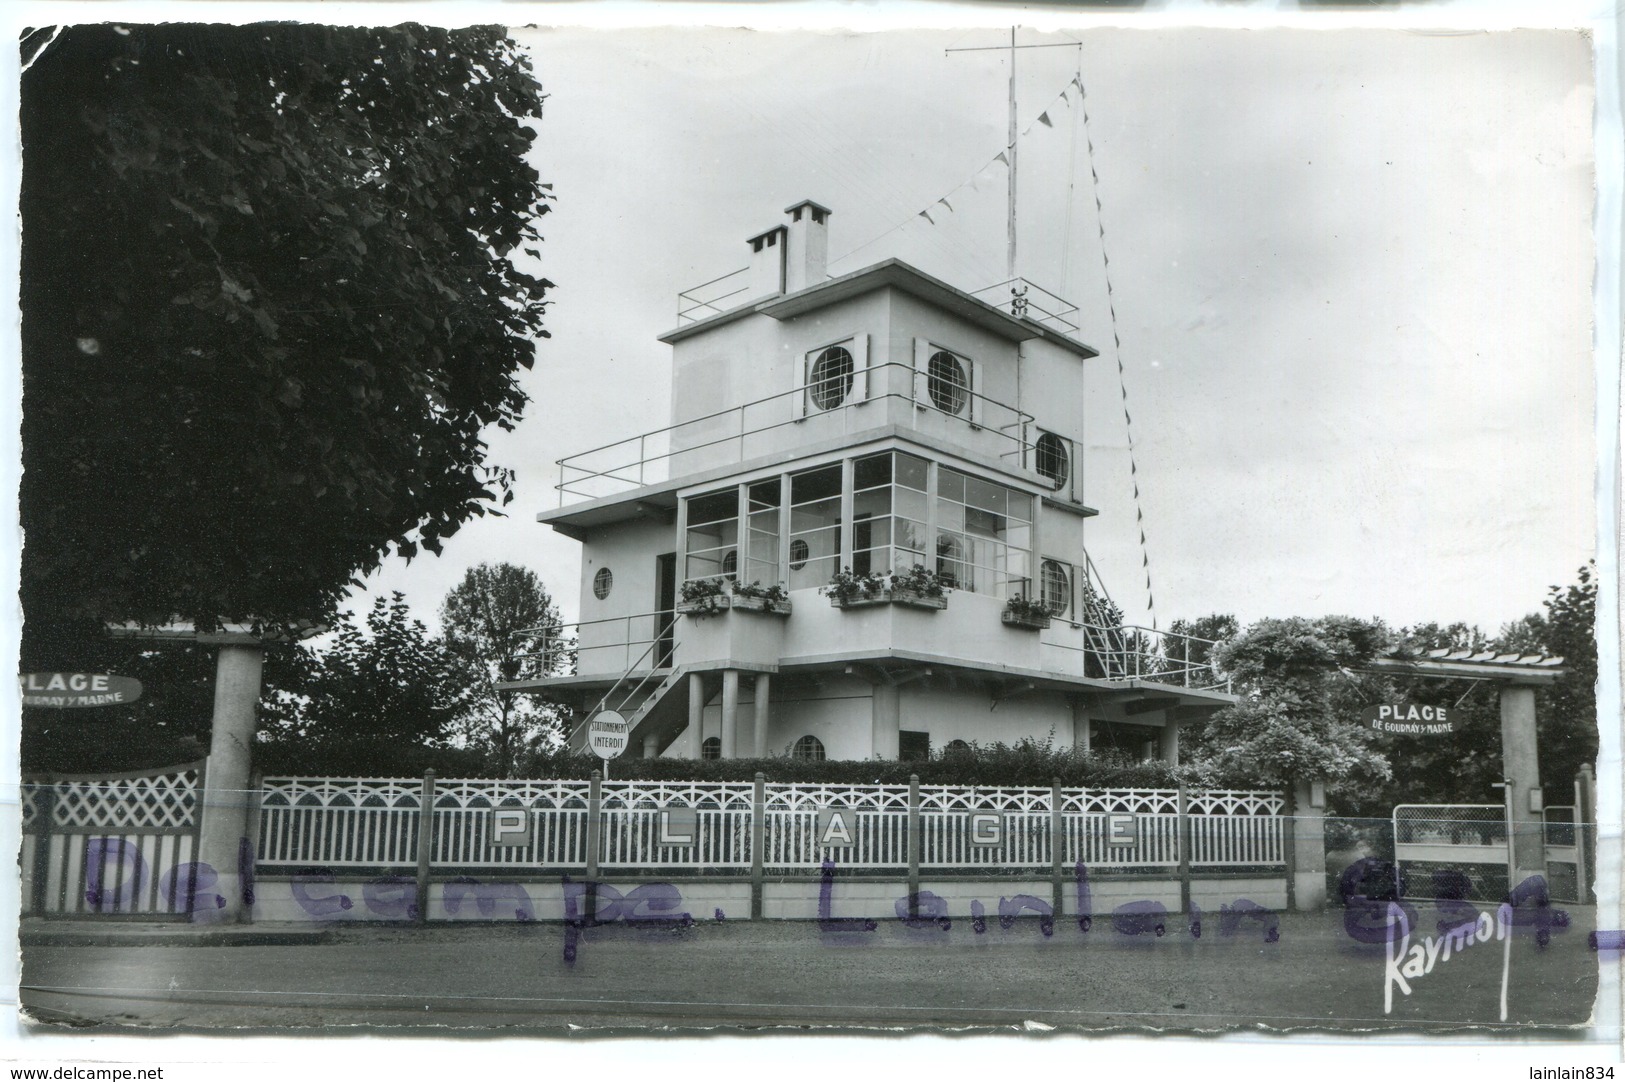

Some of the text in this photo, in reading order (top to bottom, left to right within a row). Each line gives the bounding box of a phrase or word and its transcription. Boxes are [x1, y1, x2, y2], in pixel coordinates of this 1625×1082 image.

[78, 692, 122, 705] MARNE
[1379, 704, 1447, 721] PLAGE
[591, 721, 627, 733] STATIONNEMENT
[1372, 719, 1383, 730] DE
[1427, 722, 1453, 733] MARNE
[594, 736, 624, 748] INTERDIT
